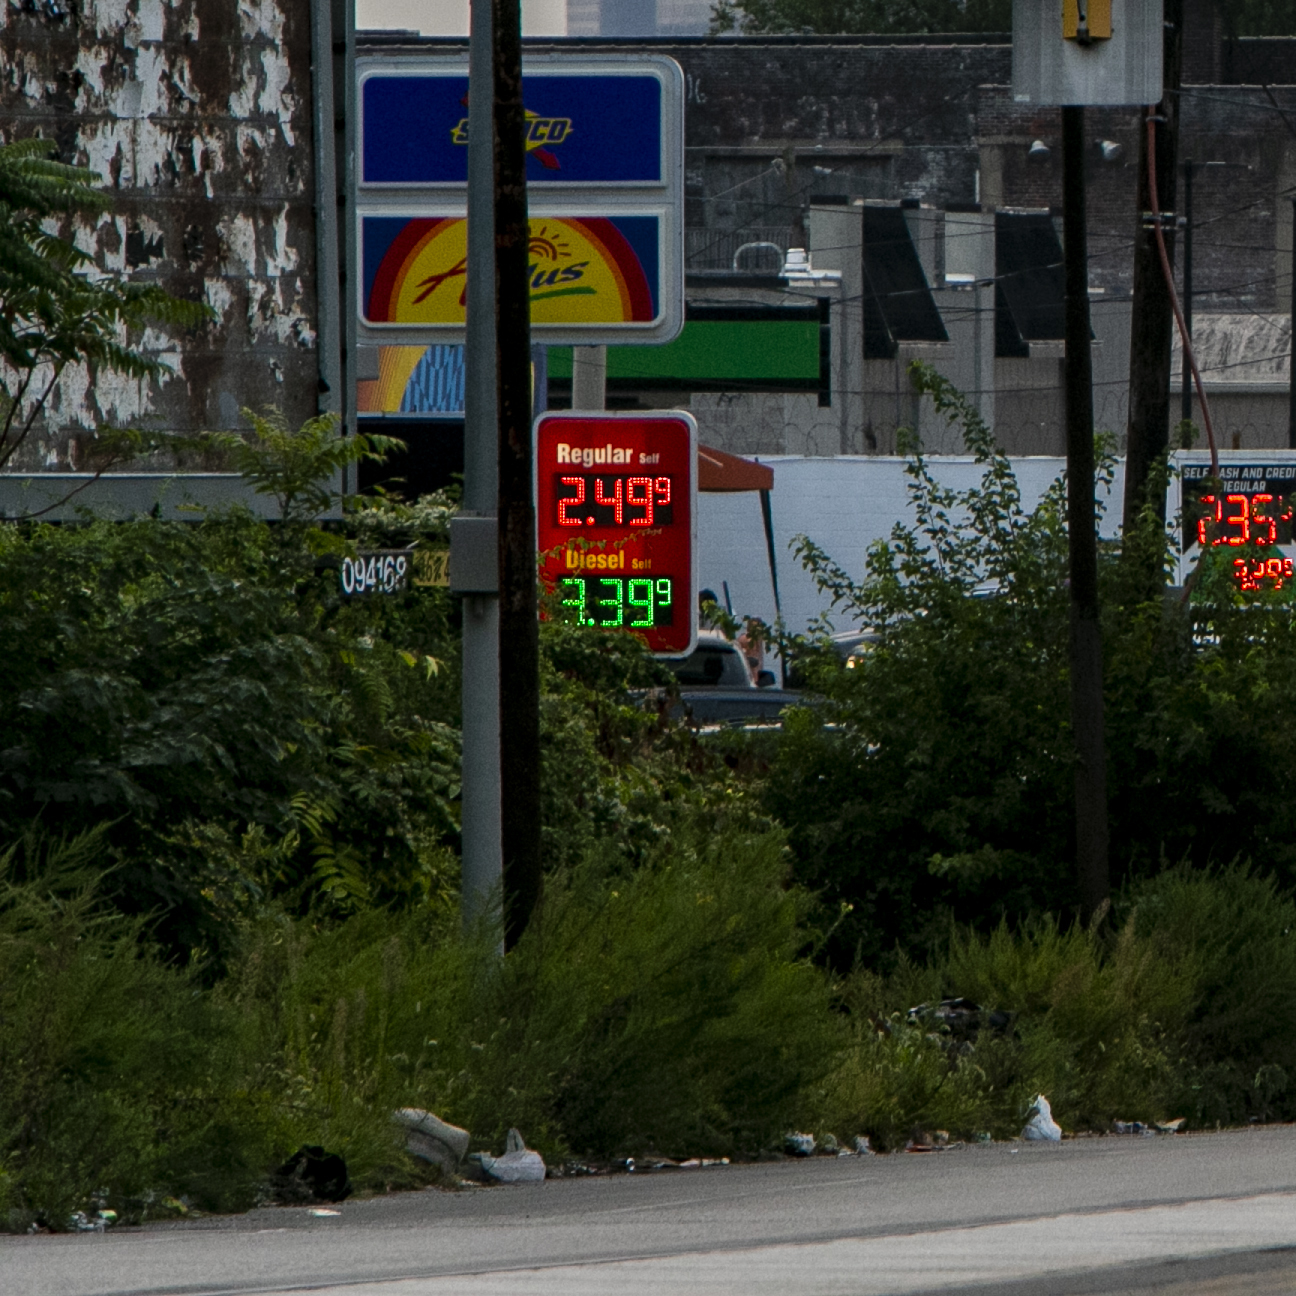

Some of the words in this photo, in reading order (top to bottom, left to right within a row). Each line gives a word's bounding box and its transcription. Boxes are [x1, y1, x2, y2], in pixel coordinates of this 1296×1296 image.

[557, 443, 633, 467] Regular
[639, 453, 661, 465] Self
[1219, 467, 1239, 478] ASH
[1241, 467, 1263, 478] AND
[565, 549, 625, 570] Diesel
[631, 558, 652, 570] Self
